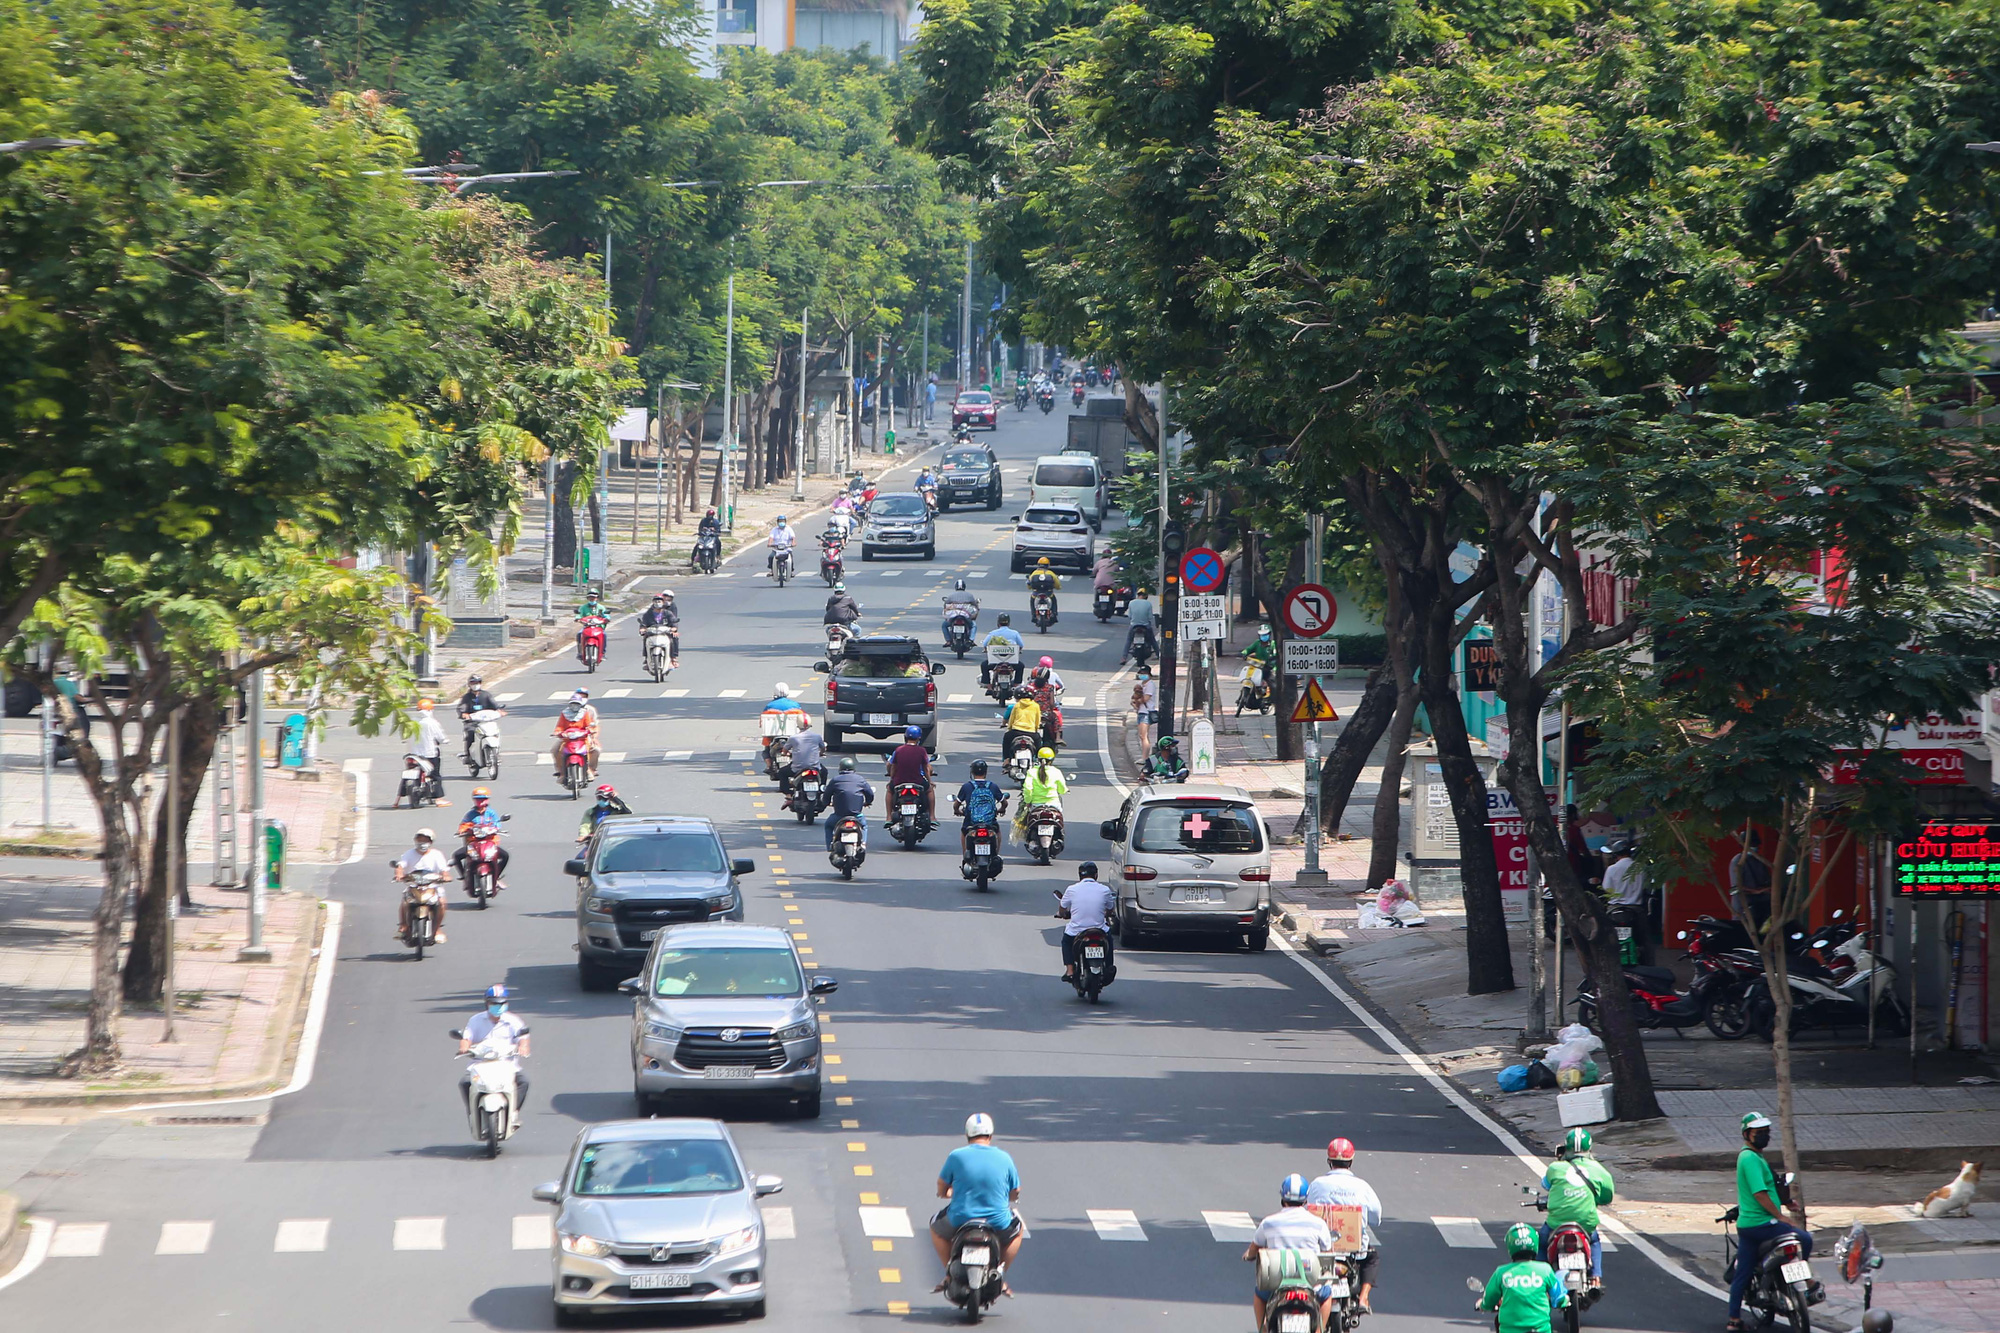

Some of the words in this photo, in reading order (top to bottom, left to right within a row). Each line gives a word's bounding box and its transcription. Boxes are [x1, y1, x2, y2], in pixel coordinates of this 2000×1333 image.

[1288, 645, 1336, 655] 10:00-12:00
[1287, 660, 1336, 670] 16:00-18:00
[1514, 1237, 1533, 1246] Grab
[631, 1274, 689, 1288] 51H-148.26
[1502, 1271, 1544, 1289] Grab
